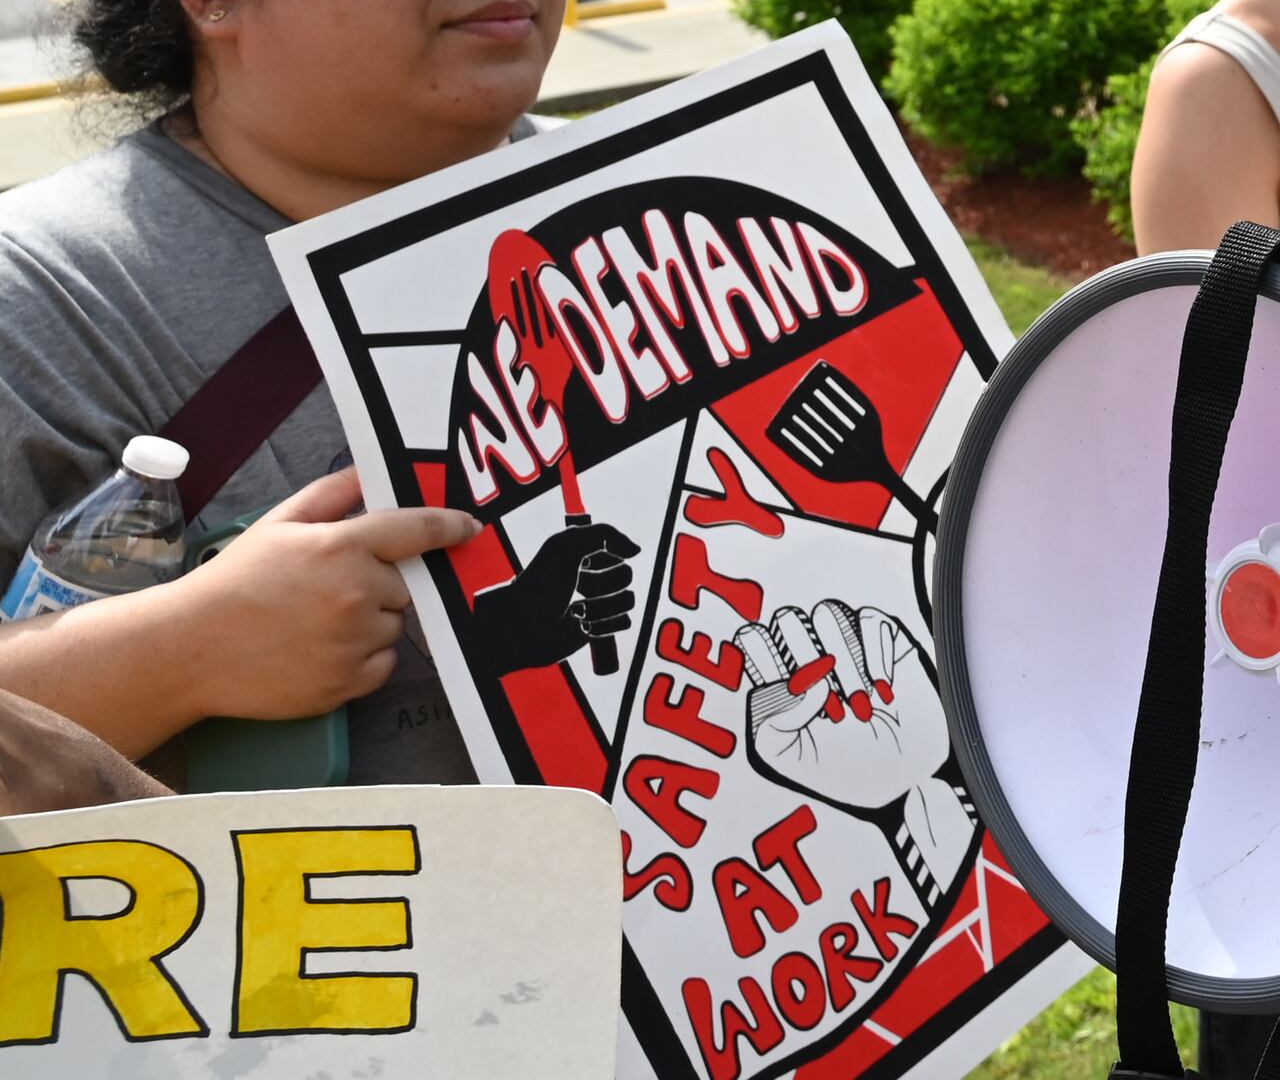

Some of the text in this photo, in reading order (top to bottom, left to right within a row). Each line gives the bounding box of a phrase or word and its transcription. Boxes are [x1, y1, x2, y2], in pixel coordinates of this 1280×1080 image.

[458, 208, 869, 506] WE DEMAND
[621, 445, 785, 913] SAFETY
[0, 824, 422, 1049] RE
[681, 876, 920, 1080] WORK
[712, 802, 823, 959] AT
